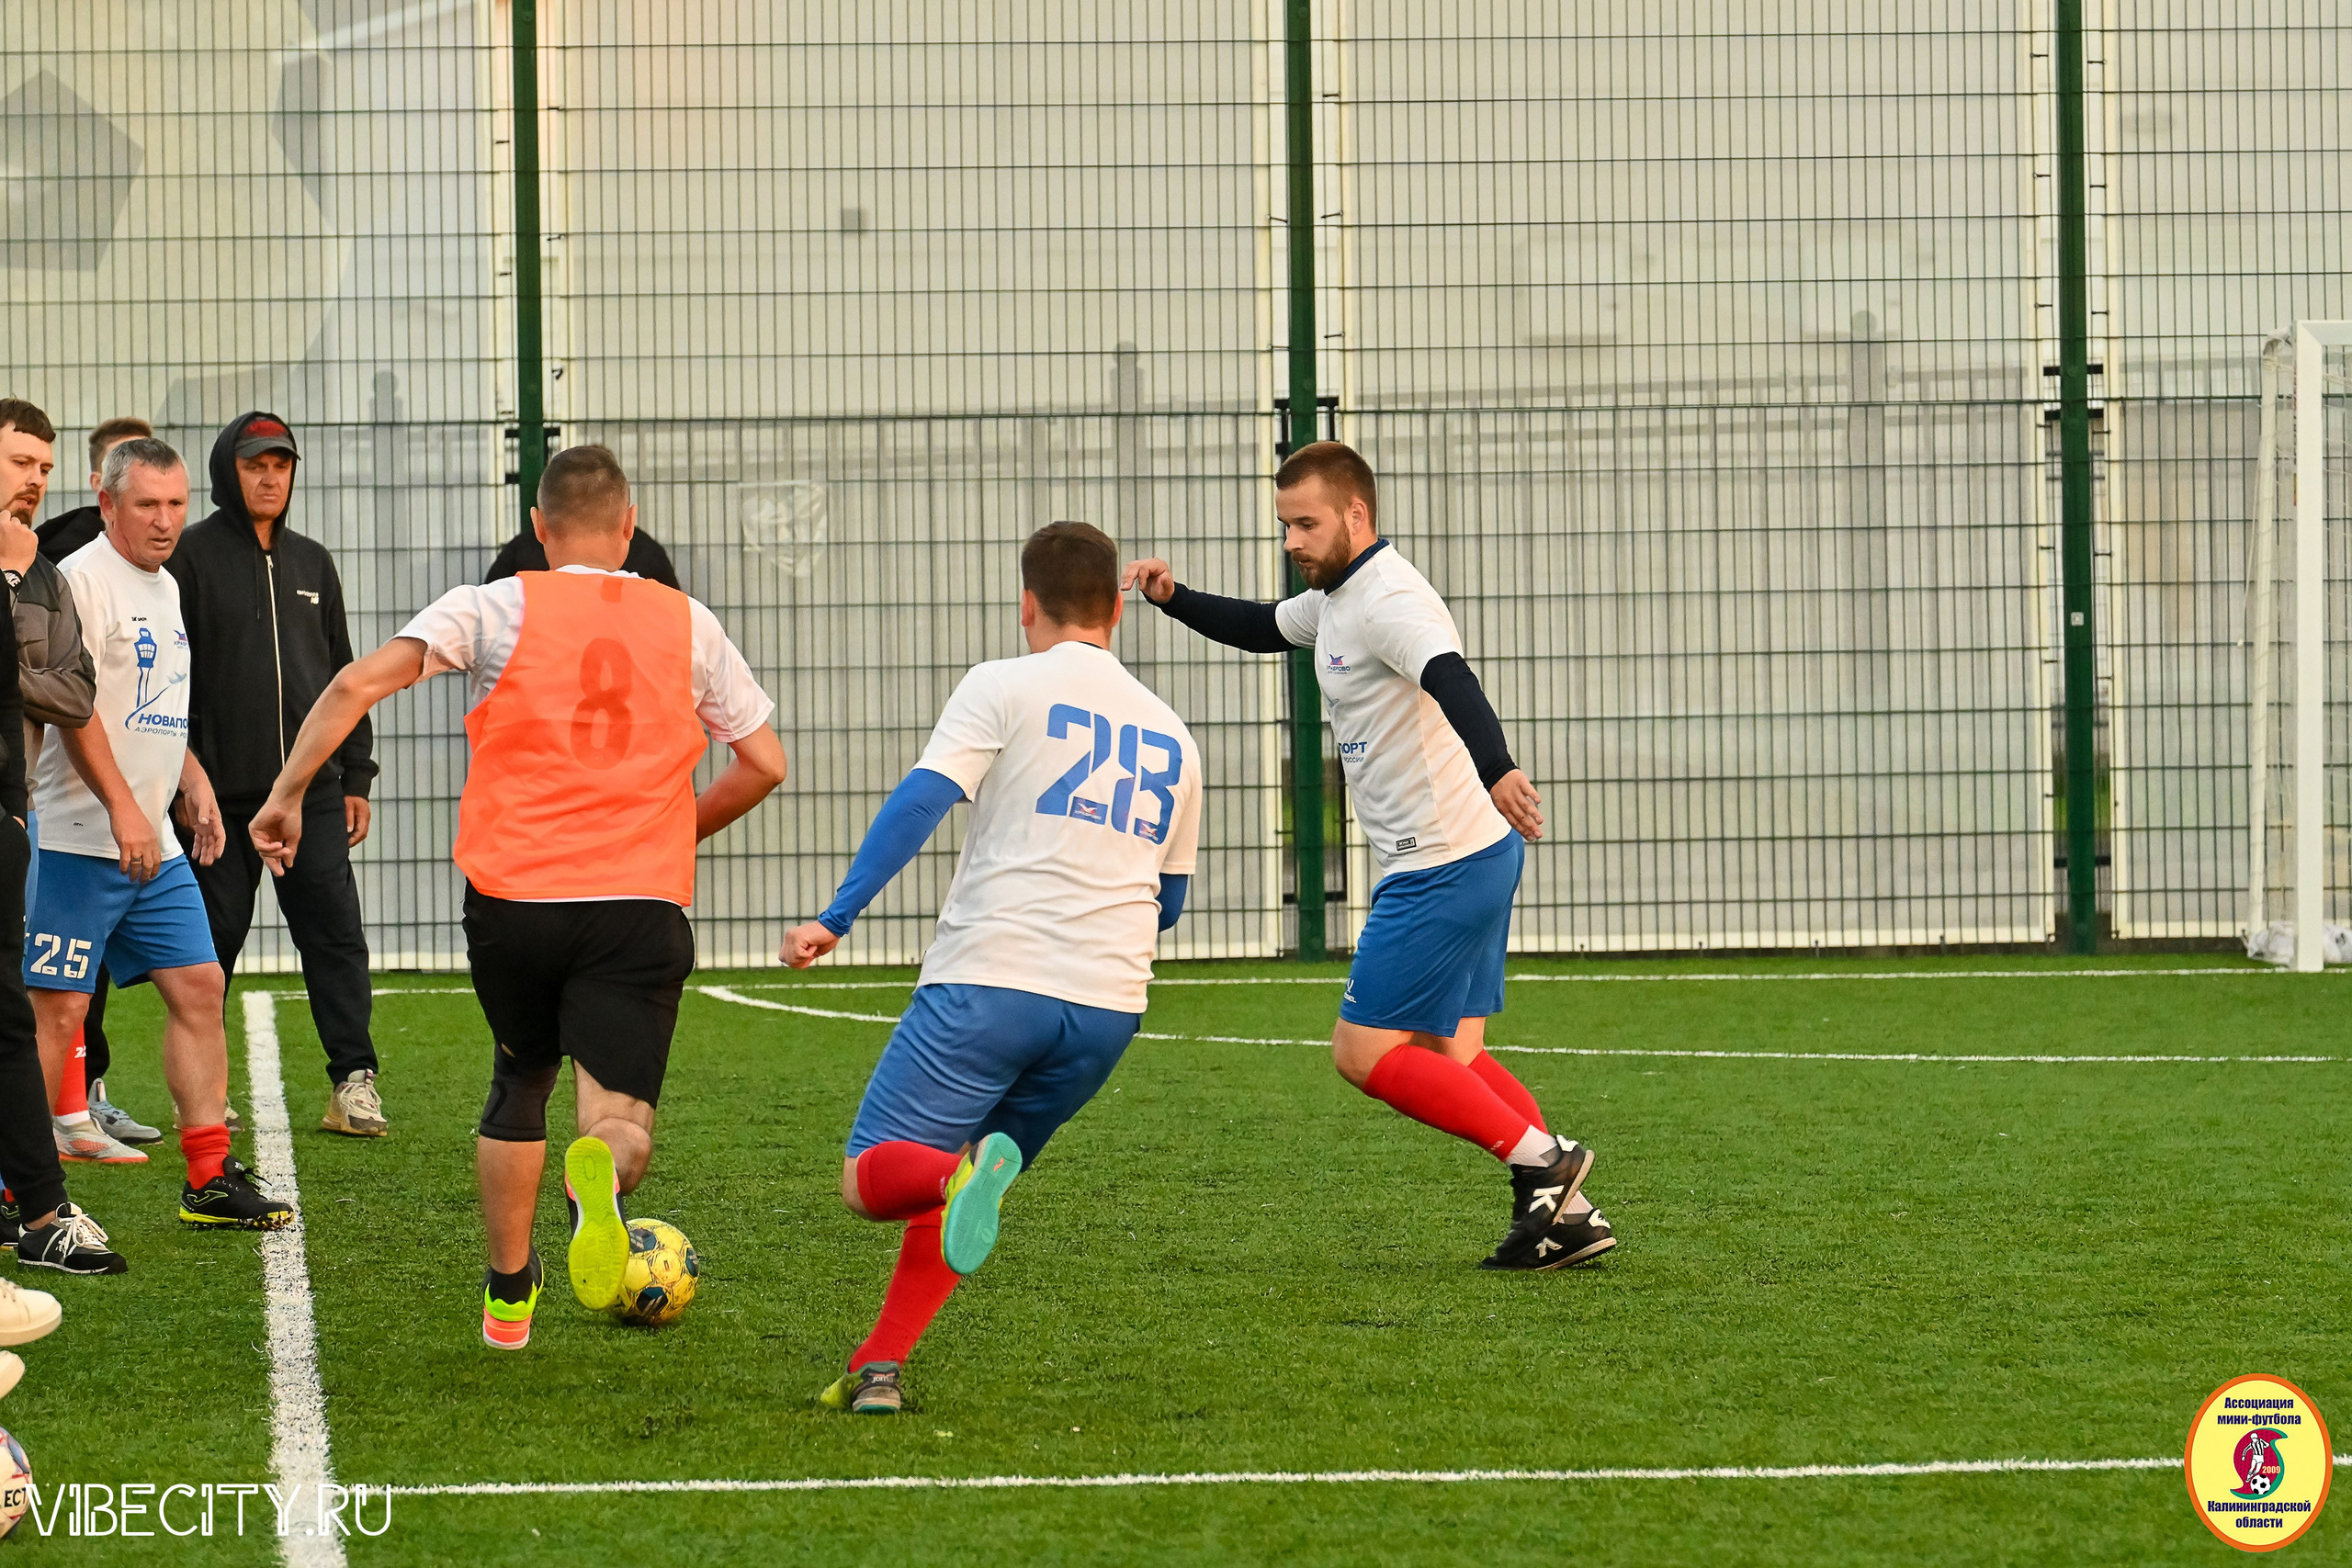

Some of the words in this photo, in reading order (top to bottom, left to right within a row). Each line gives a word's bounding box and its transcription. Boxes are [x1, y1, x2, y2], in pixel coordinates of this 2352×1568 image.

[134, 727, 177, 737] АЭРОПОРТЫ
[570, 637, 633, 770] 8
[1035, 703, 1182, 845] 28
[30, 932, 92, 979] 25
